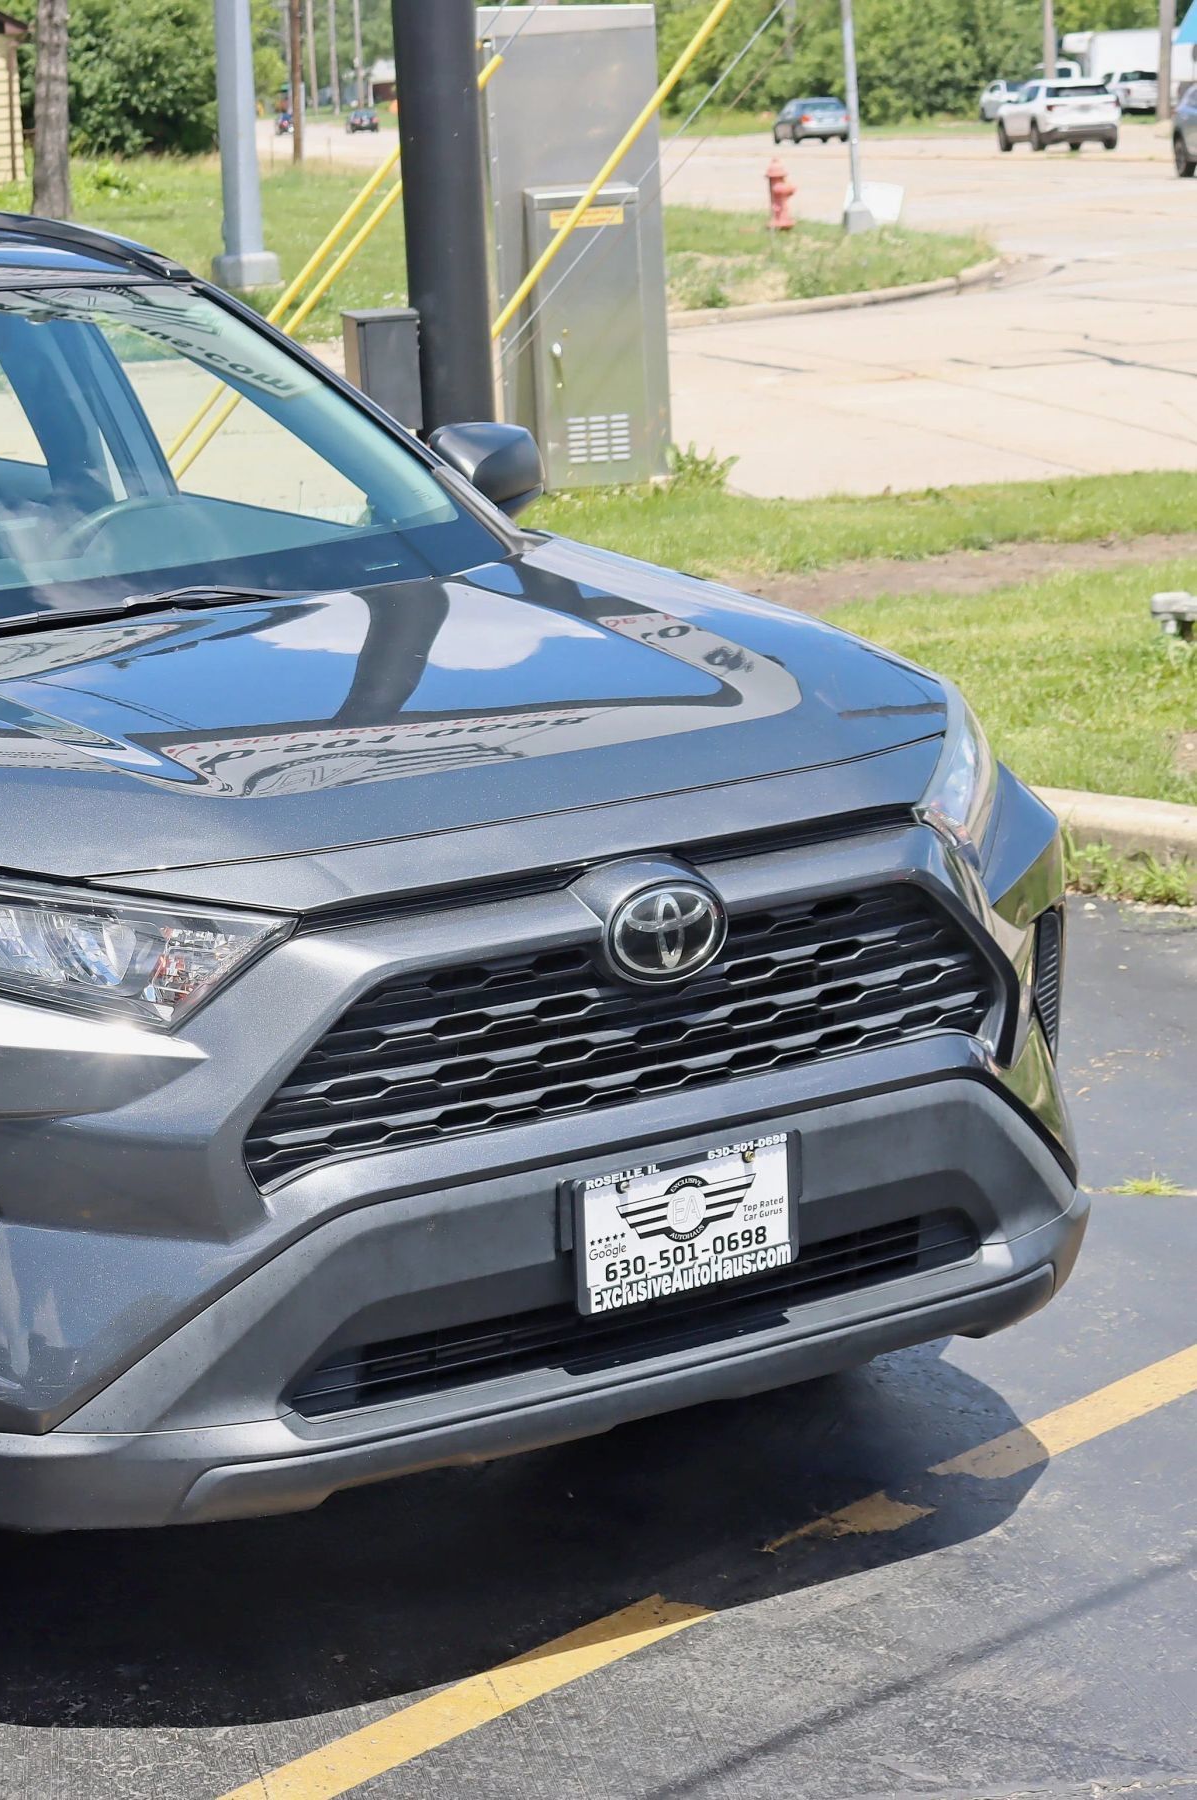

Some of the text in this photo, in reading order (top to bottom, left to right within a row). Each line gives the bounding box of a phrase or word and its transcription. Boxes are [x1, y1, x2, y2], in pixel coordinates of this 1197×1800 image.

[707, 1133, 788, 1160] 630-501-0698
[648, 1164, 660, 1176] IL
[670, 1178, 703, 1192] EXCLUSIVE
[672, 1195, 701, 1225] EA
[743, 1196, 784, 1213] Top Rated
[743, 1207, 783, 1222] Car Gurus
[669, 1224, 706, 1239] AUTOHAUS
[589, 1243, 627, 1261] Google
[605, 1226, 767, 1283] 630-501-0698
[591, 1242, 792, 1314] ExclusiveAutoHaus.com
